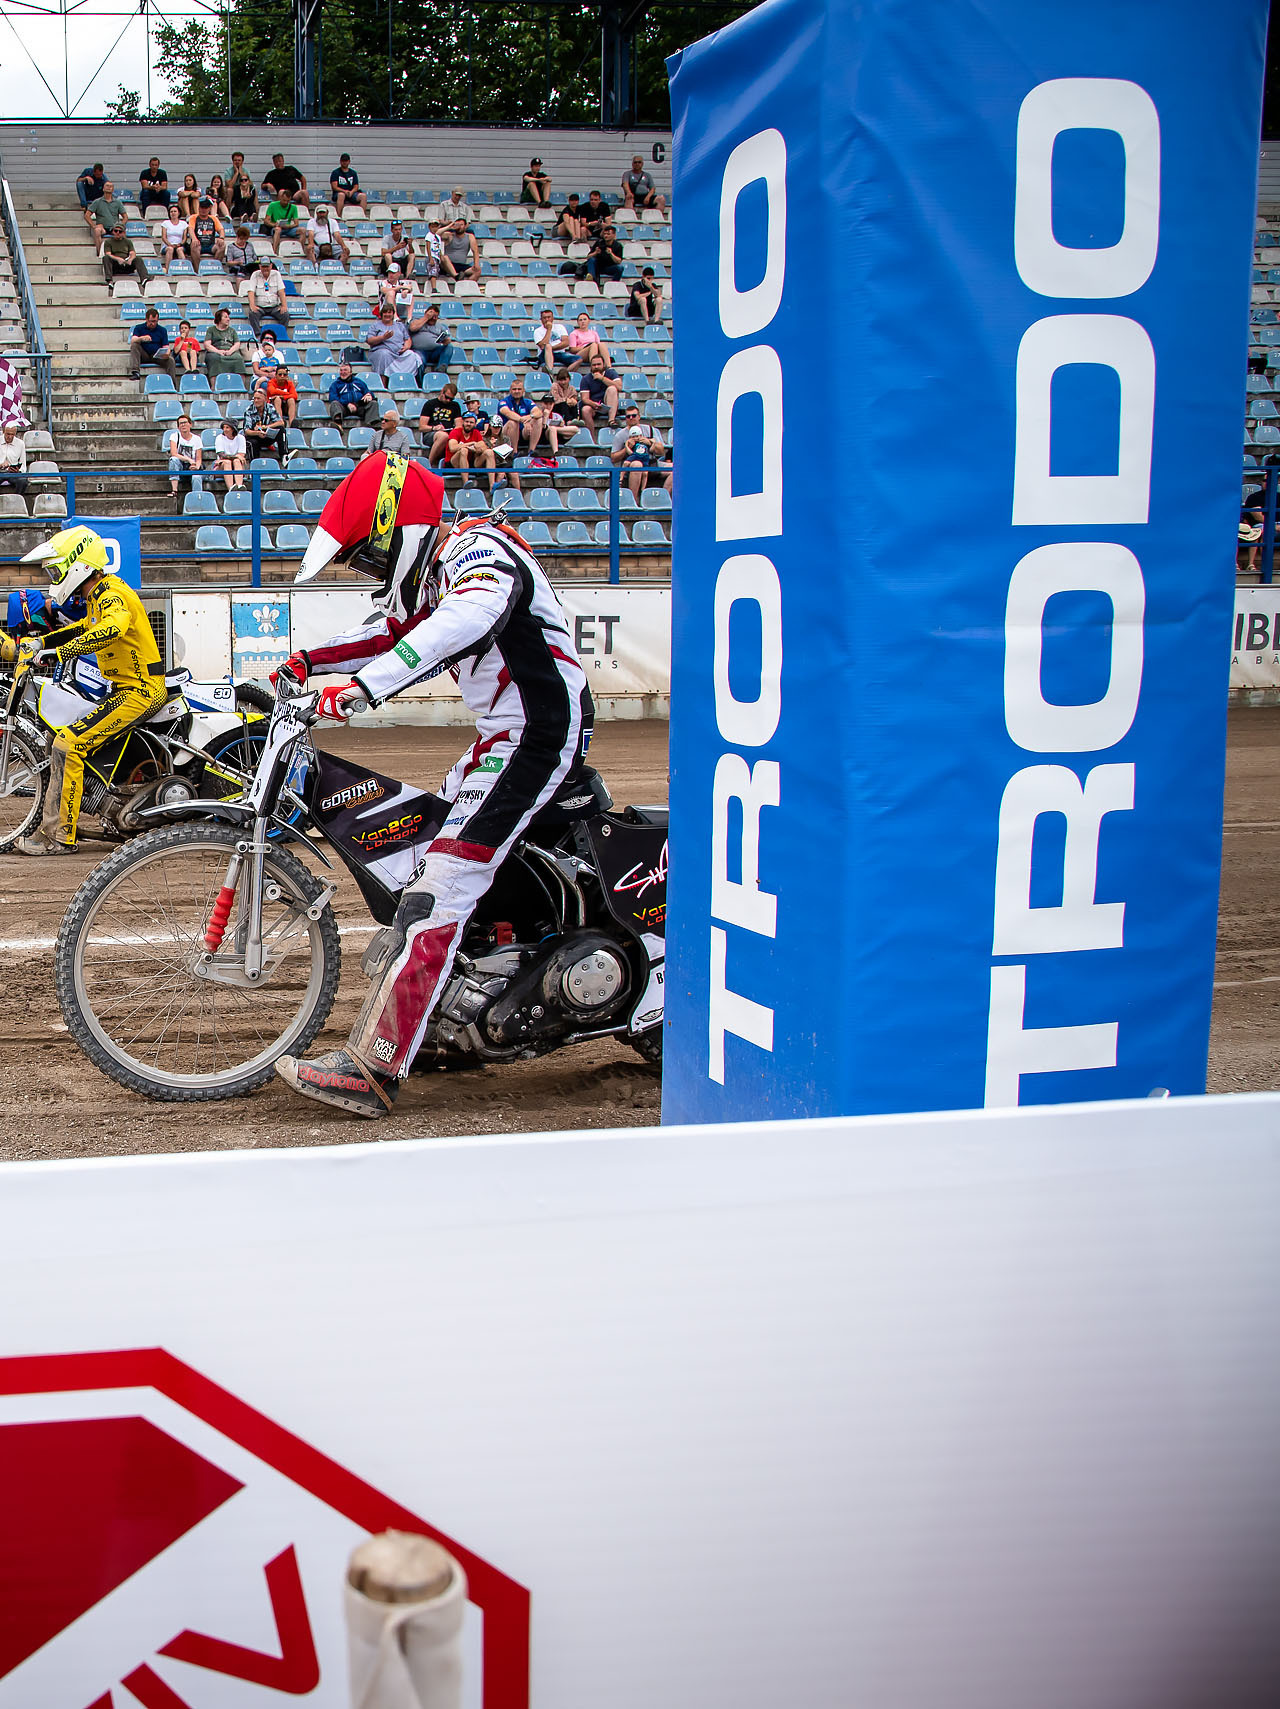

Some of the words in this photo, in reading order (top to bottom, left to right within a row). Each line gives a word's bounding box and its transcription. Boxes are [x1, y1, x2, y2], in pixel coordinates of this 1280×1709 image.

[652, 142, 665, 164] C
[63, 535, 93, 569] 100%
[984, 77, 1162, 1108] TRODO
[708, 128, 787, 1085] TRODO
[213, 687, 232, 699] 30
[365, 825, 419, 851] LONDON
[647, 913, 666, 927] LO
